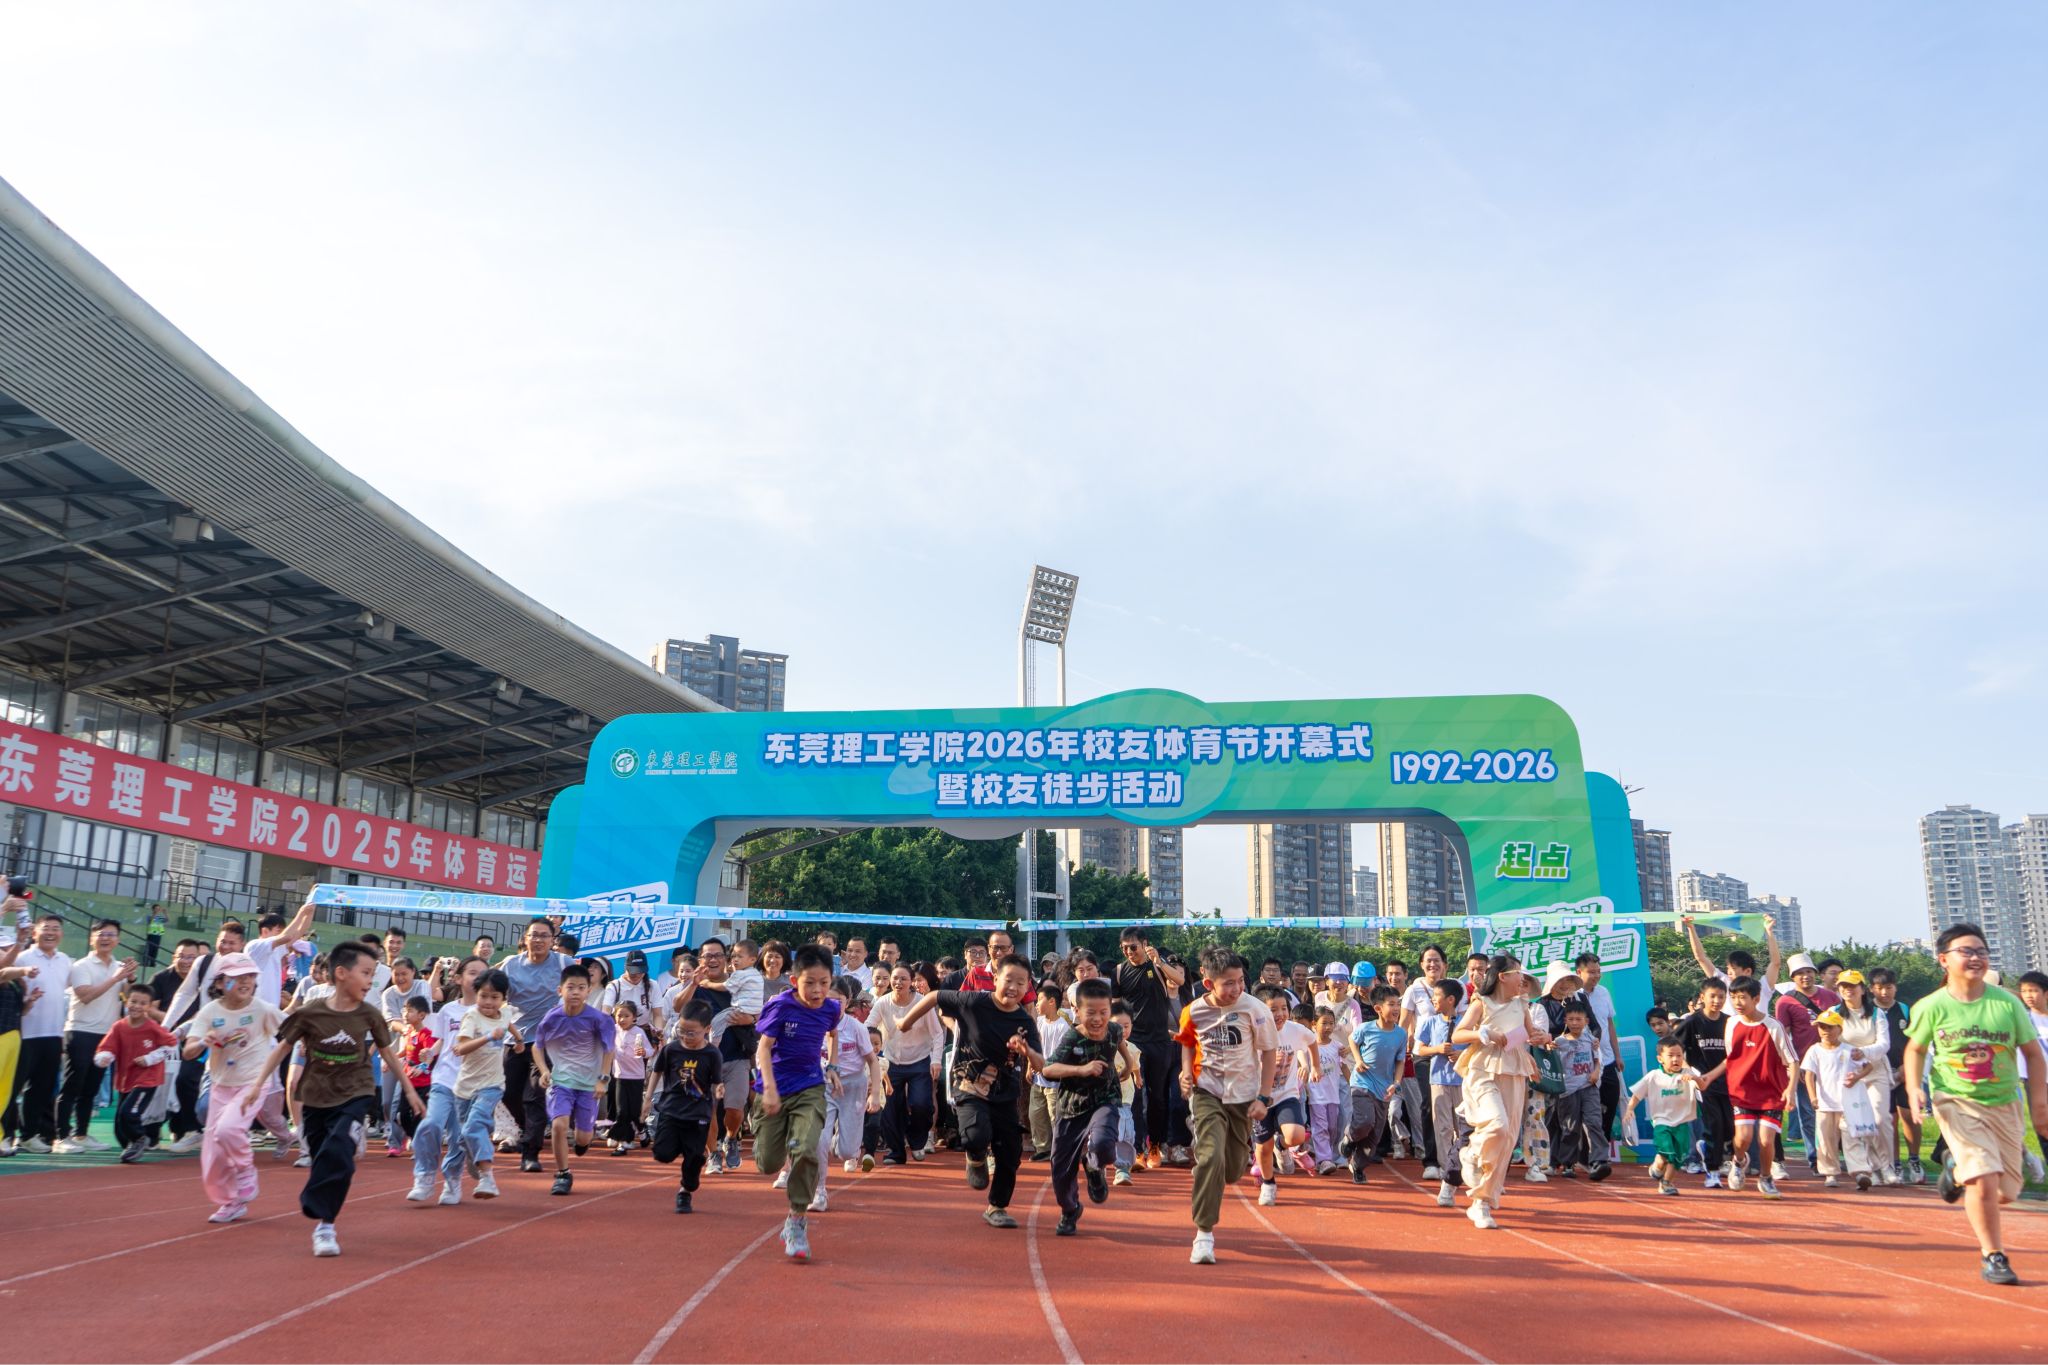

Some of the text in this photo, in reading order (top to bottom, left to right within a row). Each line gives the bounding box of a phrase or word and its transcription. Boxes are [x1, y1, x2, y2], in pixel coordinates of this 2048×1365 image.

[764, 725, 1371, 764] 东莞理工学院2026年校友体育节开幕式
[1392, 751, 1556, 782] 1992-2026
[937, 771, 1182, 805] 暨校友徒步活动
[0, 733, 541, 890] 东莞理工学院2025年体育运
[1495, 841, 1570, 878] 起点
[1487, 933, 1598, 969] 求卓越
